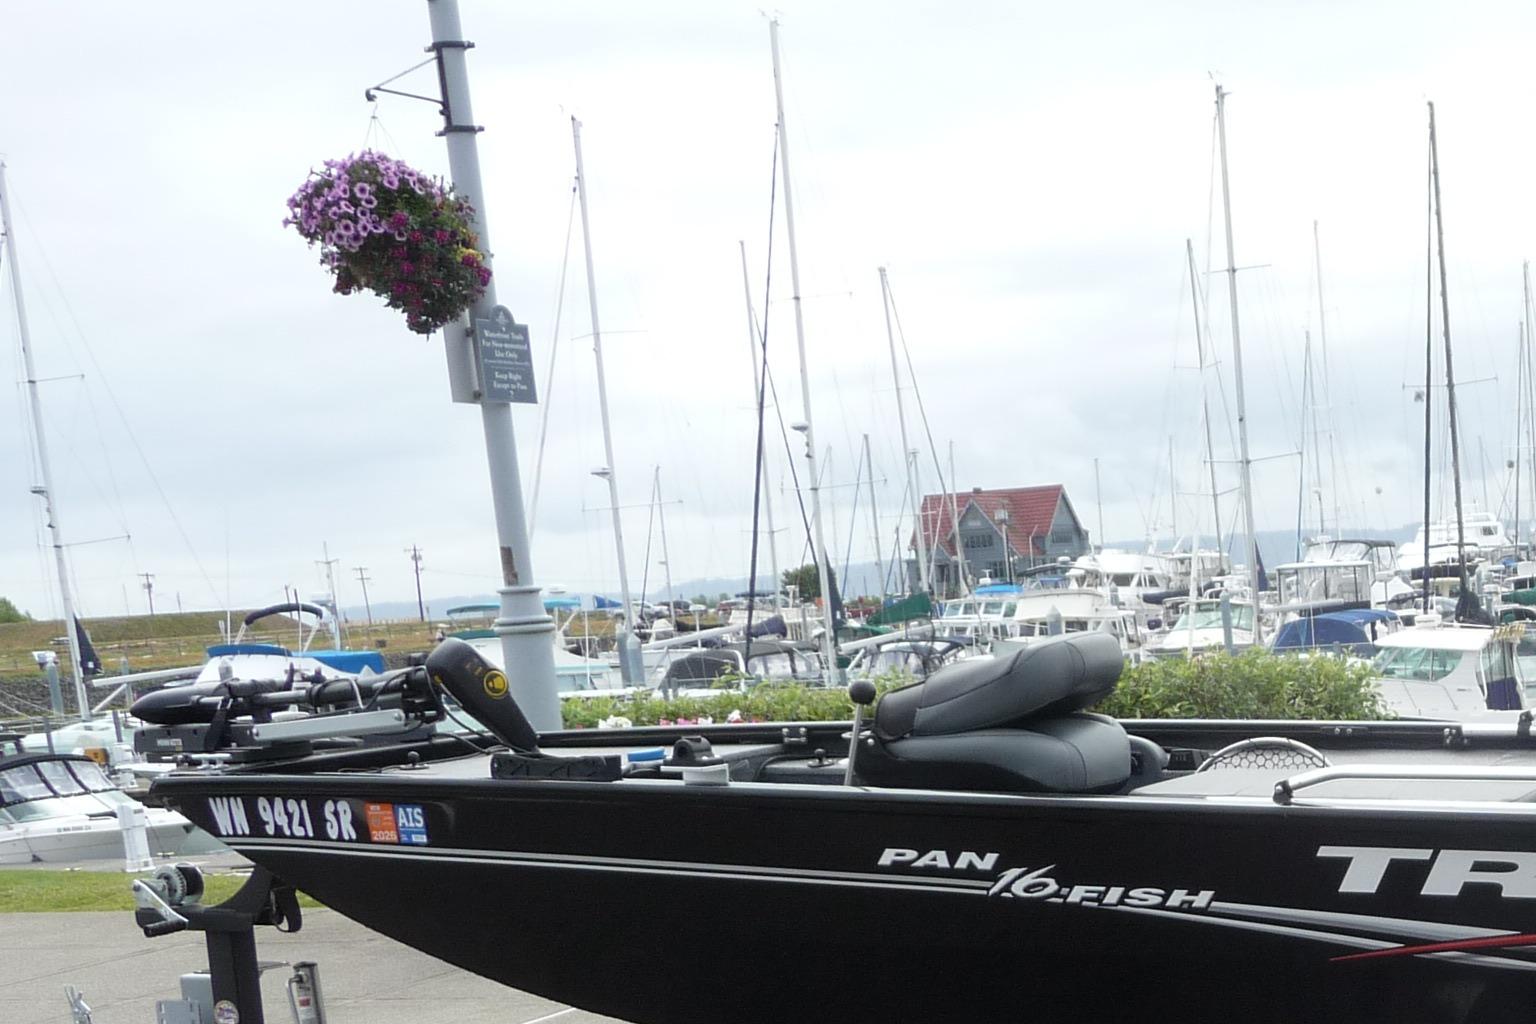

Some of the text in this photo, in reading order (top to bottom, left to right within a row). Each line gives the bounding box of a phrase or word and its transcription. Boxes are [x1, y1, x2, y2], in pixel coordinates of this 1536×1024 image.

[208, 797, 357, 840] WN 9421 SR
[398, 807, 424, 828] AIS
[877, 848, 1216, 908] PAN 16 FISH
